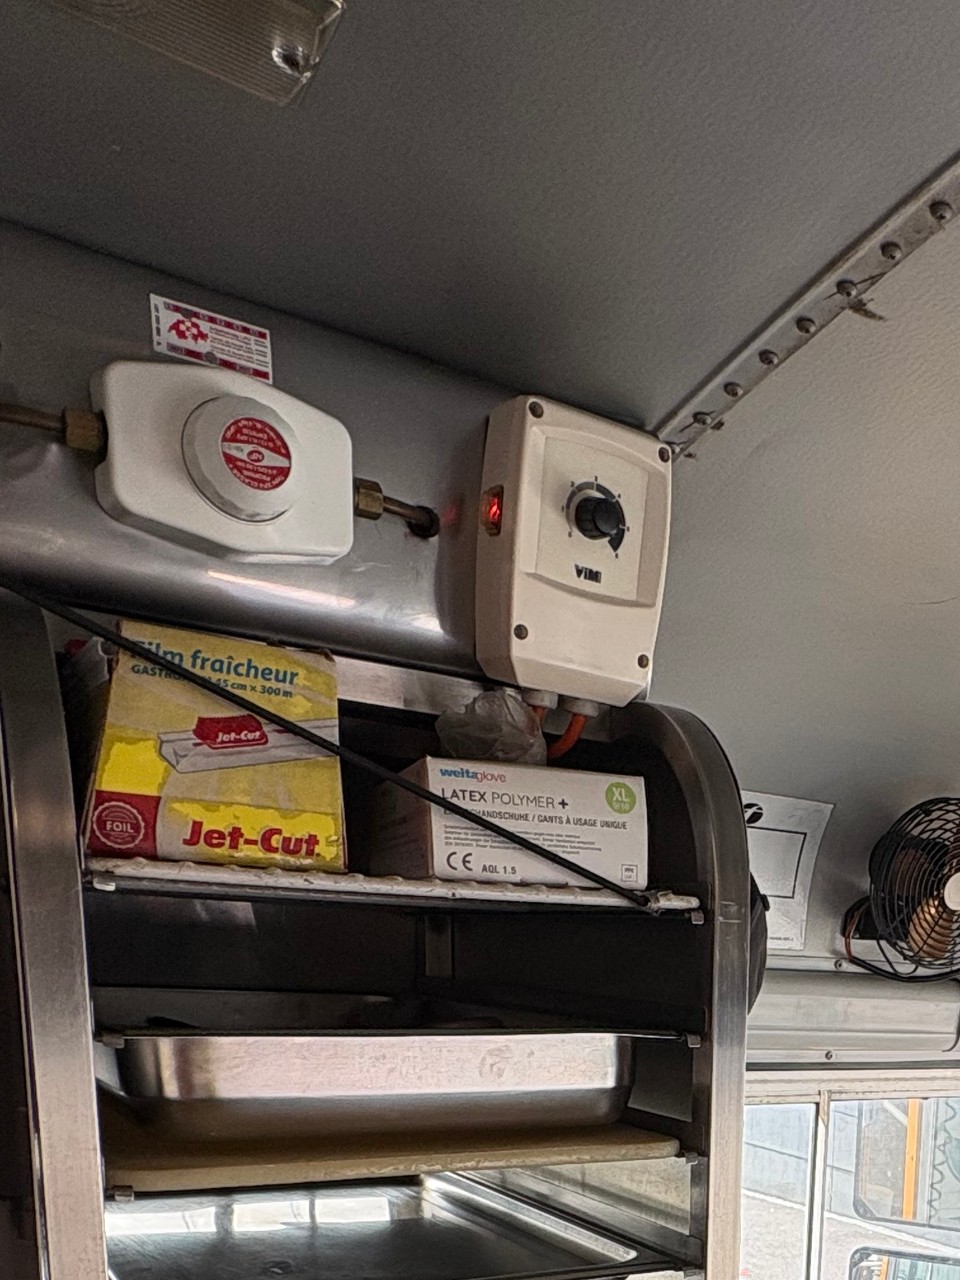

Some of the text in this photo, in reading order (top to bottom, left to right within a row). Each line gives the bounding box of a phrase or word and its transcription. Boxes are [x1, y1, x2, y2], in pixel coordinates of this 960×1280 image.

[130, 640, 298, 685] lm fraîcheur
[230, 682, 247, 691] cm
[260, 685, 280, 696] 300
[282, 689, 293, 698] m
[217, 731, 261, 742] Jet-Cut
[441, 788, 487, 803] LATEX
[492, 792, 555, 808] POLYMER
[612, 787, 630, 802] XL
[106, 820, 134, 833] FOIL
[538, 815, 563, 824] GANTS
[573, 817, 597, 827] USAGE
[600, 820, 627, 830] UNIQUE
[182, 820, 320, 857] Jet-Cut
[481, 864, 517, 874] AQL 1.5
